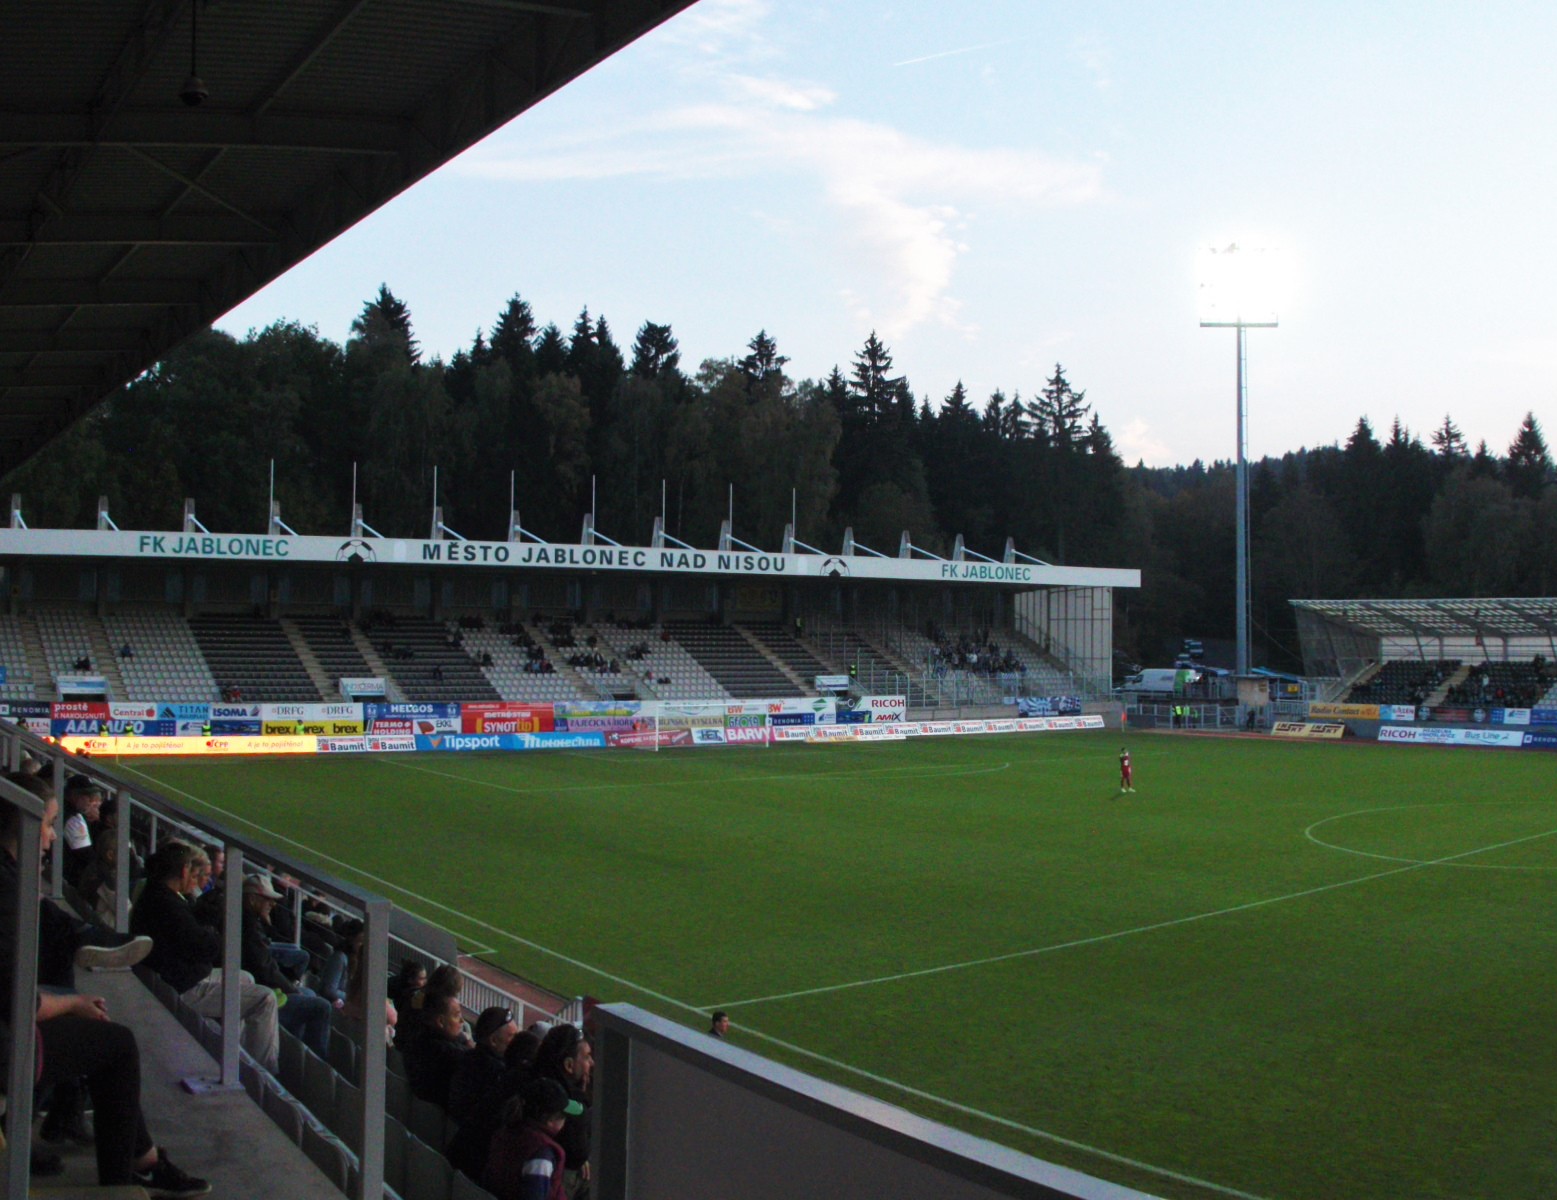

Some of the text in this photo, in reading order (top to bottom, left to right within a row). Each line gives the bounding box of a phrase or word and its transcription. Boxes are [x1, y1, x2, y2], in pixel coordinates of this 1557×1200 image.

[139, 535, 289, 556] FK JABLONEC
[422, 539, 786, 572] MĚSTO JABLONEC NAD NISOU
[941, 563, 1031, 581] FK JABLONEC
[391, 704, 434, 713] HELGOS
[872, 700, 904, 708] RICOH
[213, 708, 247, 717] ISOMA
[66, 720, 100, 733] AAA
[265, 724, 291, 734] brex
[333, 724, 358, 734] brex
[728, 728, 770, 741] BARVY
[1380, 730, 1416, 738] RICOH
[330, 742, 364, 750] Baumit
[381, 742, 415, 750] Baumit
[444, 735, 500, 750] Tipsport
